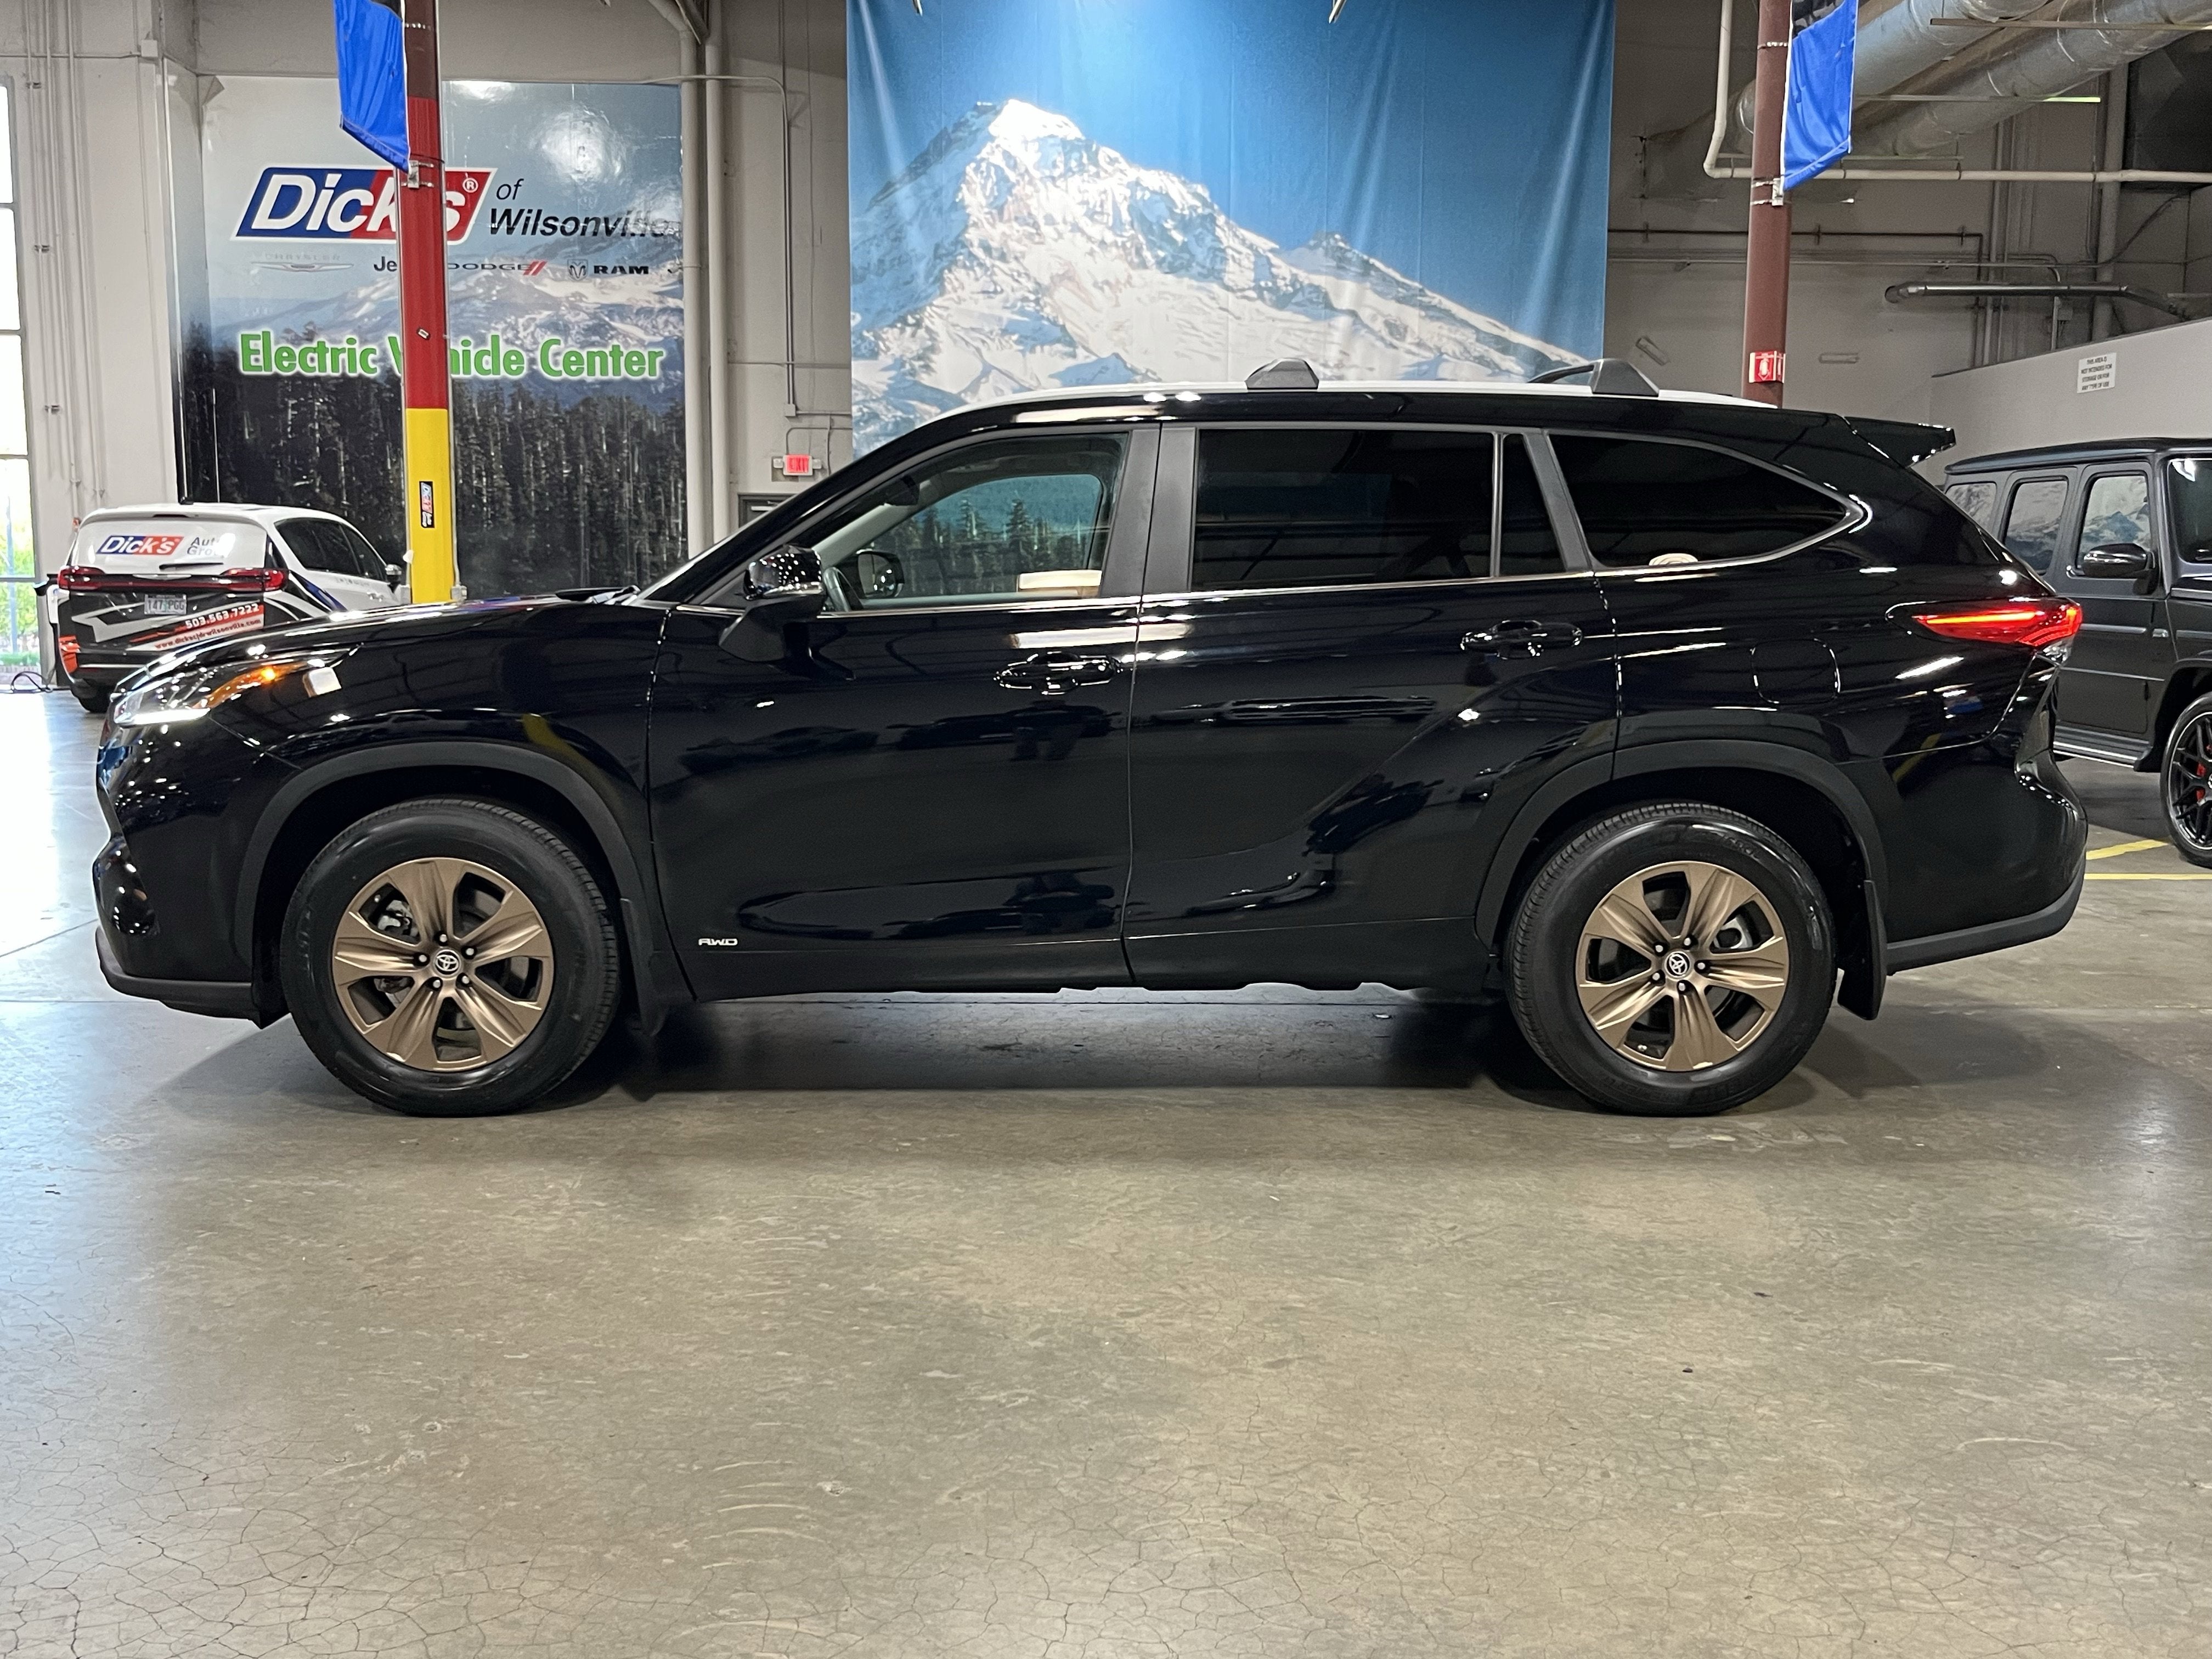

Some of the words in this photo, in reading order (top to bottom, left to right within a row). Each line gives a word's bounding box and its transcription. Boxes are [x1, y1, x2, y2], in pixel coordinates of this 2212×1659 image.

[496, 178, 524, 200] of
[251, 173, 466, 233] Dicks
[490, 208, 664, 237] Wilsonvi
[373, 256, 398, 272] Je
[594, 265, 649, 274] RAM
[241, 331, 377, 375] Electric
[388, 334, 525, 376] Vicle
[541, 338, 664, 377] Center
[788, 458, 809, 472] EXIT
[100, 537, 175, 554] Dick's
[190, 537, 219, 546] Aut
[187, 545, 225, 558] Gro
